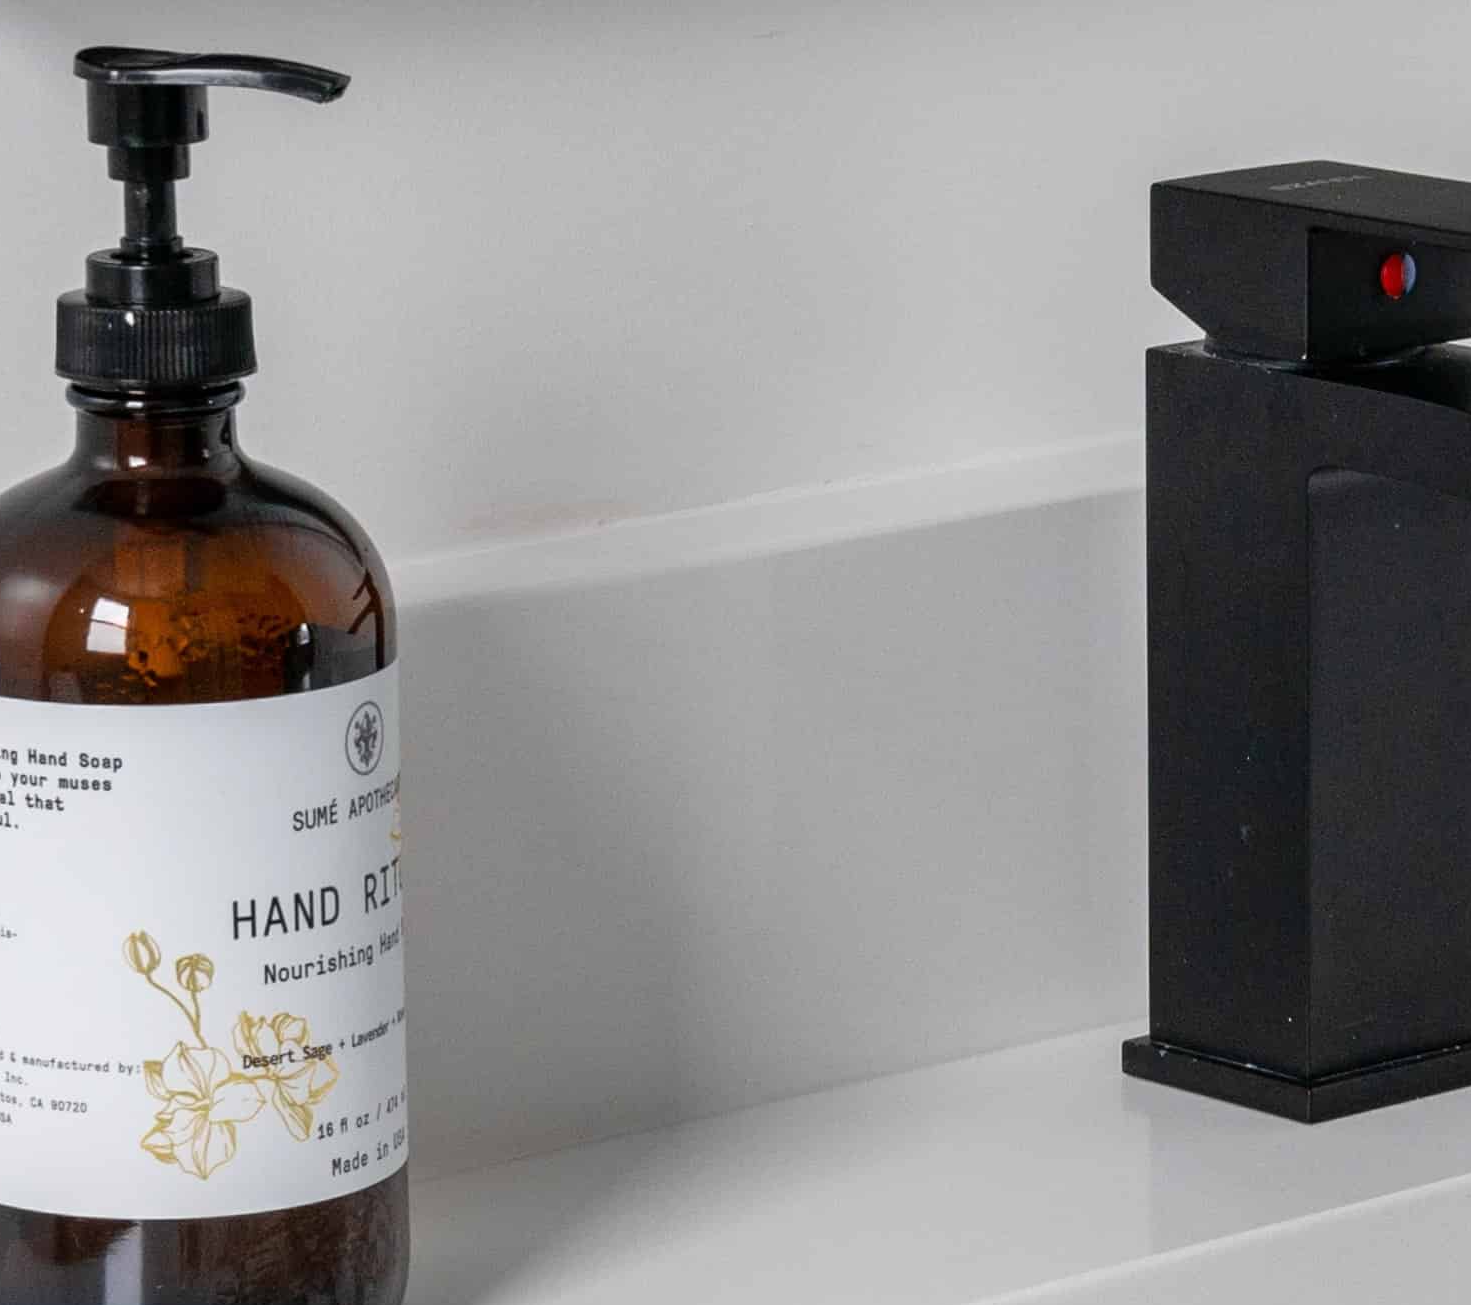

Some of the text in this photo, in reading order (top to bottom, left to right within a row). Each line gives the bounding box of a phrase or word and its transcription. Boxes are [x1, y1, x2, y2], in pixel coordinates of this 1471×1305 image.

[27, 748, 68, 767] Hand
[79, 753, 123, 772] Soap
[10, 771, 48, 788] your
[58, 776, 113, 791] muses
[24, 793, 65, 812] that
[292, 798, 338, 832] SUMÉ
[232, 855, 402, 940] HAND RIT
[264, 945, 374, 985] Nourishing
[242, 1050, 296, 1070] Desert
[303, 1043, 333, 1061] Sage
[351, 1020, 390, 1048] Lavender
[5, 1070, 29, 1086] Inc.
[22, 1055, 110, 1074] manufactured
[118, 1063, 141, 1077] by:
[29, 1096, 44, 1109] CA
[317, 1121, 334, 1140] 16
[356, 1112, 370, 1128] oz
[331, 1151, 369, 1177] Made
[376, 1141, 389, 1161] in
